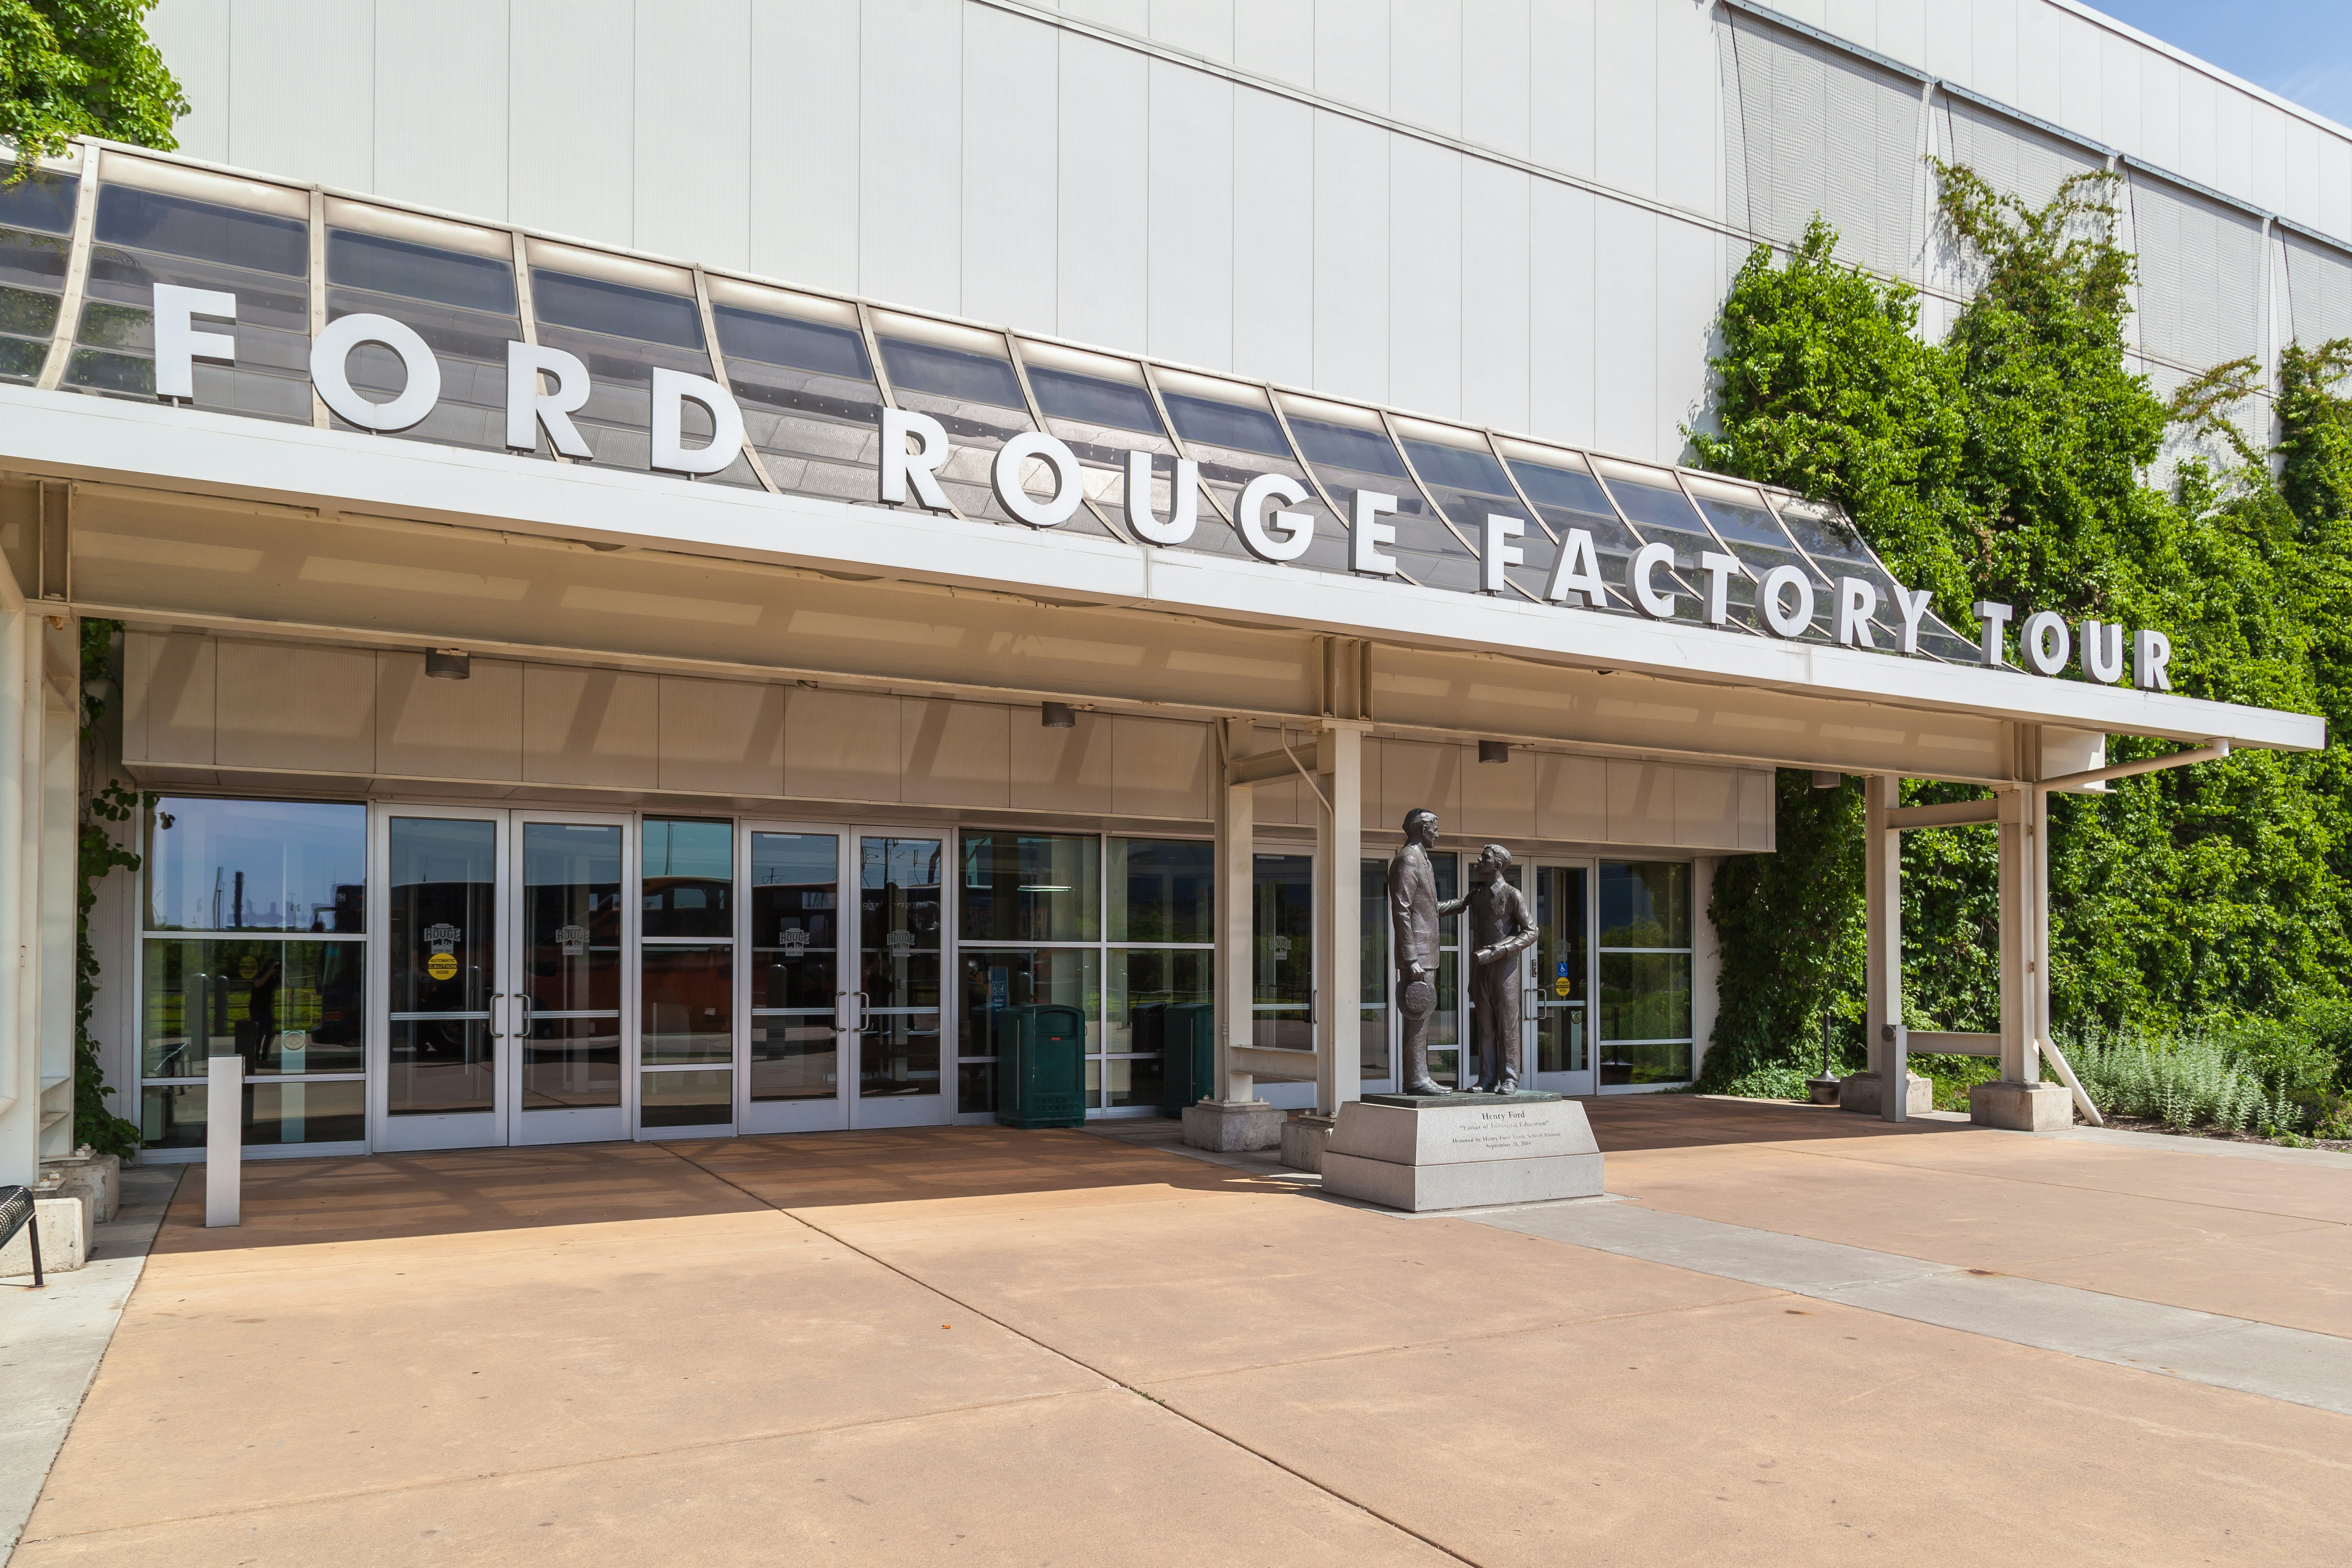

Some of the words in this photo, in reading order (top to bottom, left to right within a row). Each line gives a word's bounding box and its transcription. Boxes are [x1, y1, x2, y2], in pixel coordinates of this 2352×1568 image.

[153, 283, 744, 476] FORD
[878, 407, 1397, 576] ROUGE
[1480, 513, 1934, 654] FACTORY
[1974, 601, 2171, 690] TOUR
[426, 929, 460, 940] ROUGE
[558, 930, 589, 940] ROUGE
[781, 933, 809, 943] ROUGE
[888, 934, 914, 944] ROUGE
[1482, 1113, 1505, 1121] Henry
